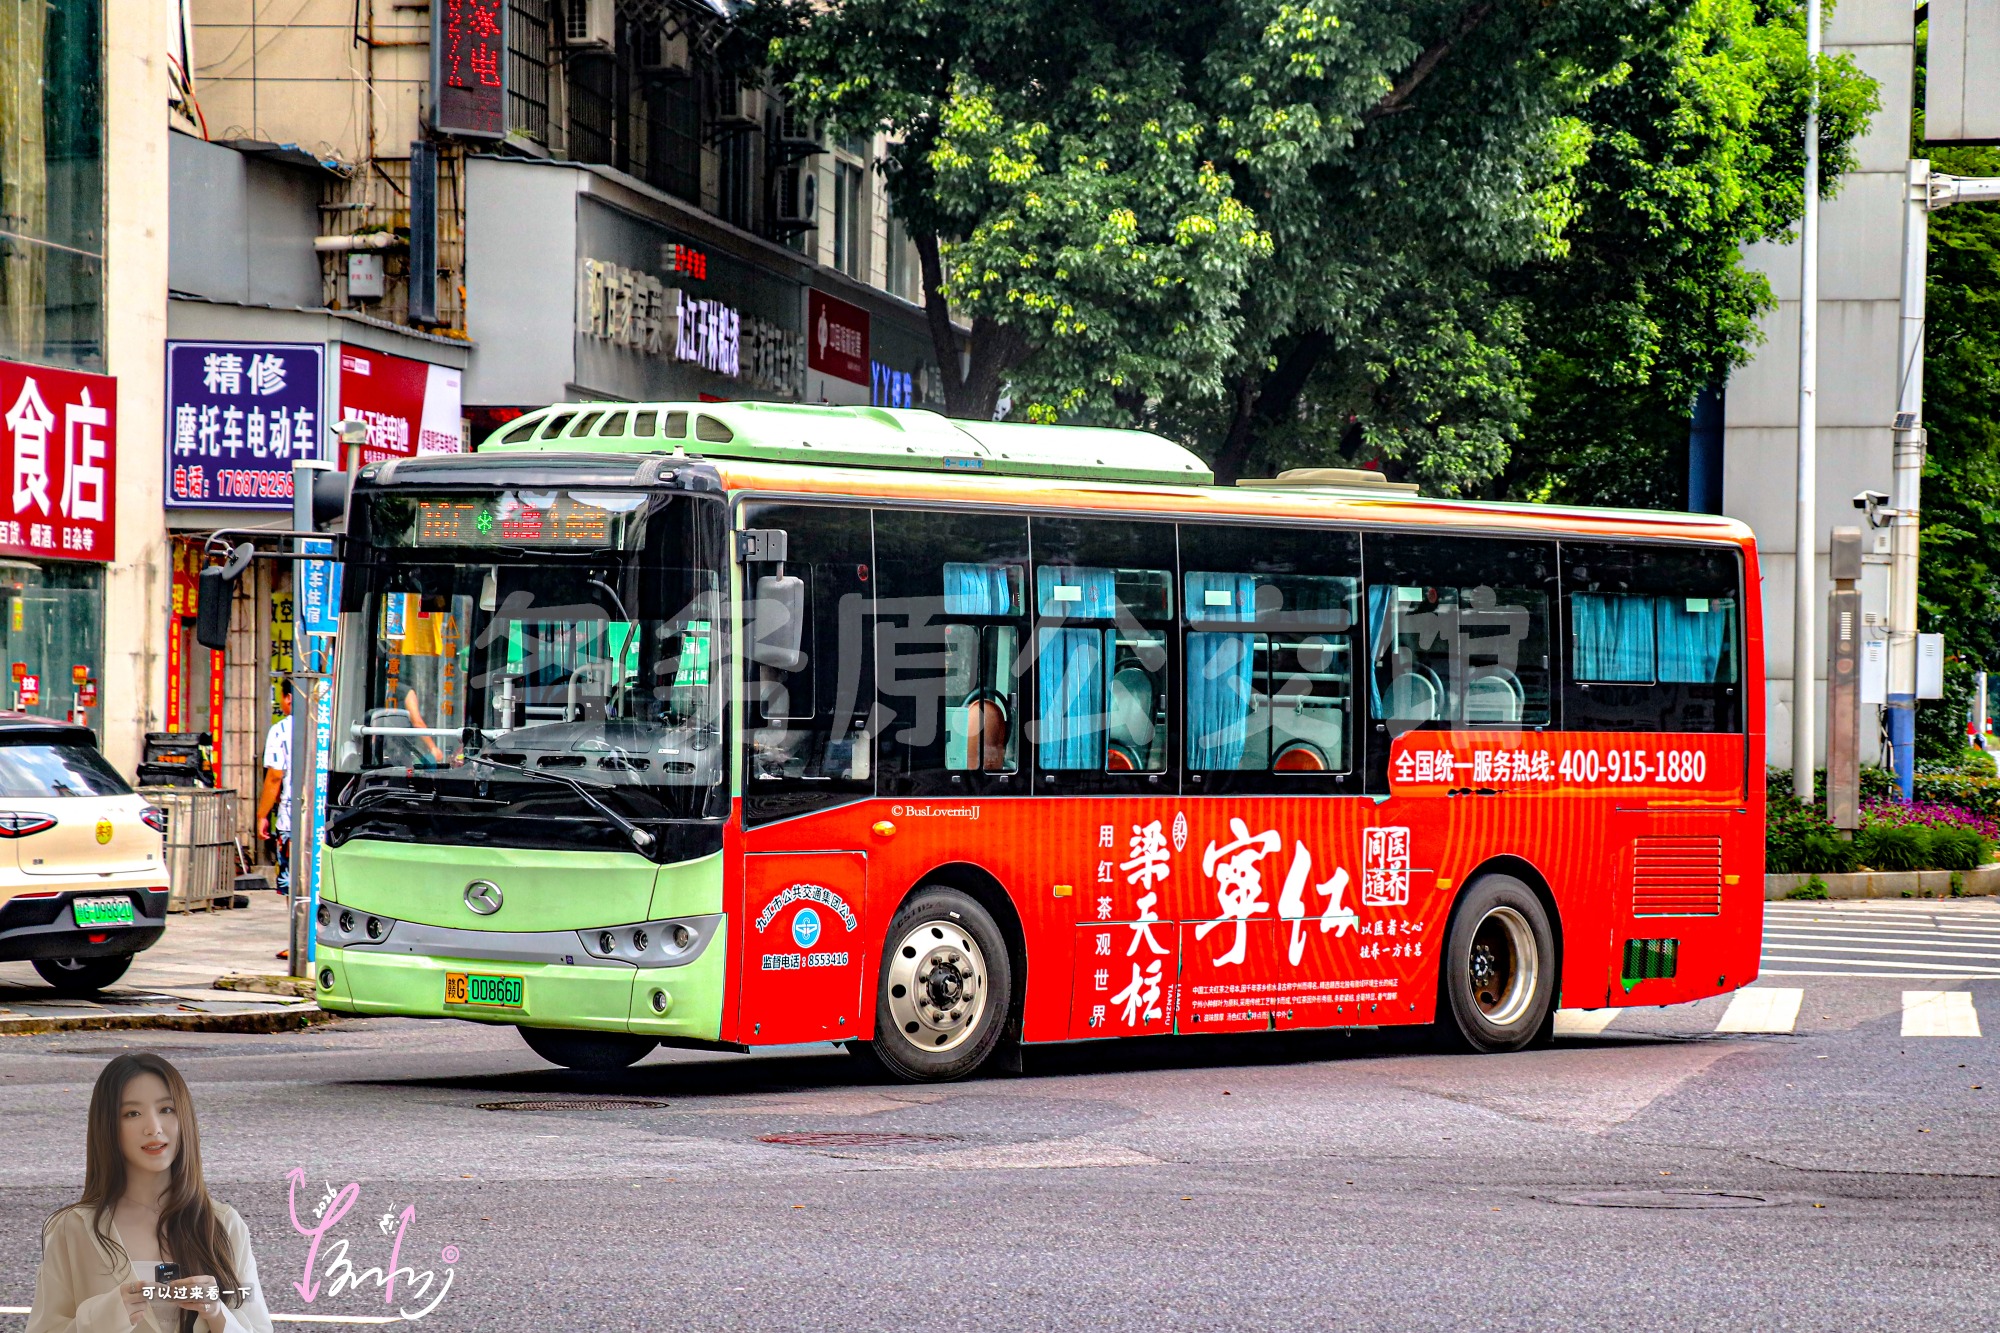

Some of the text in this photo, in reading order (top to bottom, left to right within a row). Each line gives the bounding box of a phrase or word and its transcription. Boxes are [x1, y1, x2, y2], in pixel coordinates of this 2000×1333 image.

[203, 352, 288, 396] 精修
[5, 376, 108, 522] 食店
[174, 403, 314, 459] 摩托车电动车
[365, 410, 410, 453] 天能电池
[22, 677, 36, 690] 拉
[756, 884, 858, 933] 九江市公共交通集团公司
[1094, 825, 1114, 1028] 用红茶观世界
[1110, 819, 1173, 1027] 梁天柱
[1361, 919, 1423, 936] 以医者之心
[1164, 984, 1174, 1026] TIANZHU
